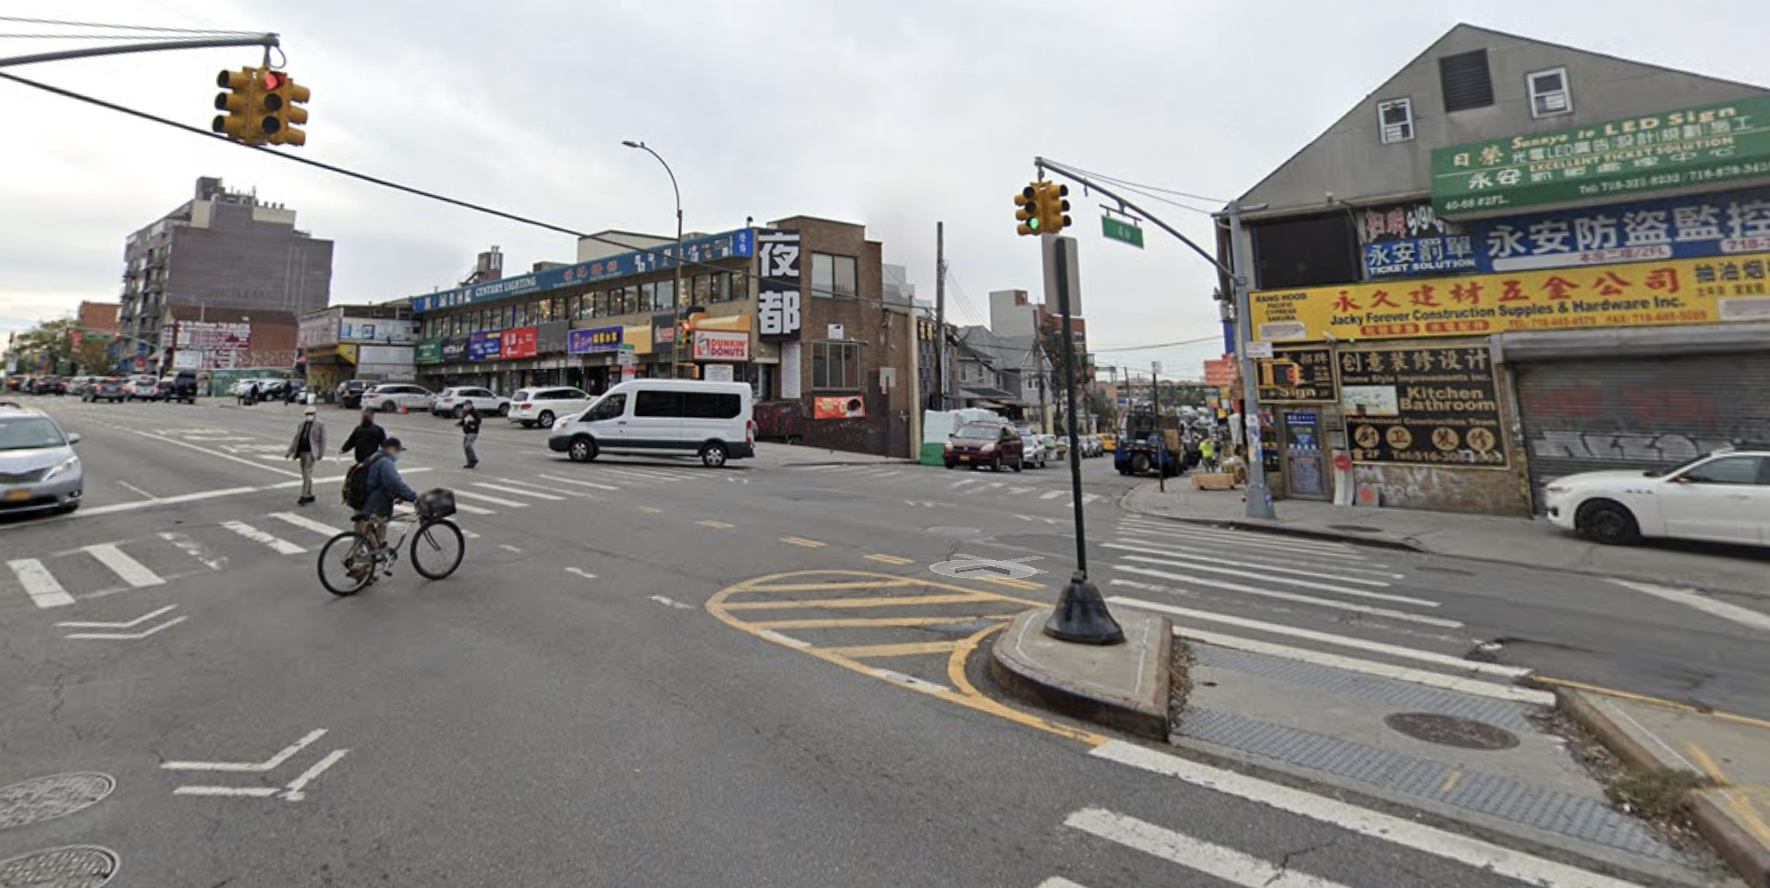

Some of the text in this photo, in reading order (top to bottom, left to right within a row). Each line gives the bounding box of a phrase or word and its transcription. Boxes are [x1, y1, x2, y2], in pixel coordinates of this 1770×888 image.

[1604, 116, 1661, 136] LED
[1667, 106, 1738, 126] Sign
[1604, 147, 1652, 163] TICKET
[1655, 136, 1734, 156] SOLUTION
[1369, 257, 1476, 275] TICKET SOLUTION
[758, 232, 801, 335] 夜都
[1331, 267, 1680, 313] 永久建材五金公司
[1284, 292, 1308, 300] HOOD
[1330, 312, 1363, 326] Jacky
[1366, 309, 1410, 323] Forever
[1412, 304, 1495, 320] Construction
[1558, 301, 1569, 313] &
[1572, 297, 1650, 312] Hardware
[1654, 293, 1686, 308] Inc.
[711, 338, 747, 347] DUNKIN'
[711, 348, 745, 357] DONUTS
[1342, 349, 1488, 373] 创意装修设计
[1406, 386, 1484, 400] Kitchen
[1400, 397, 1496, 412] Bathroom
